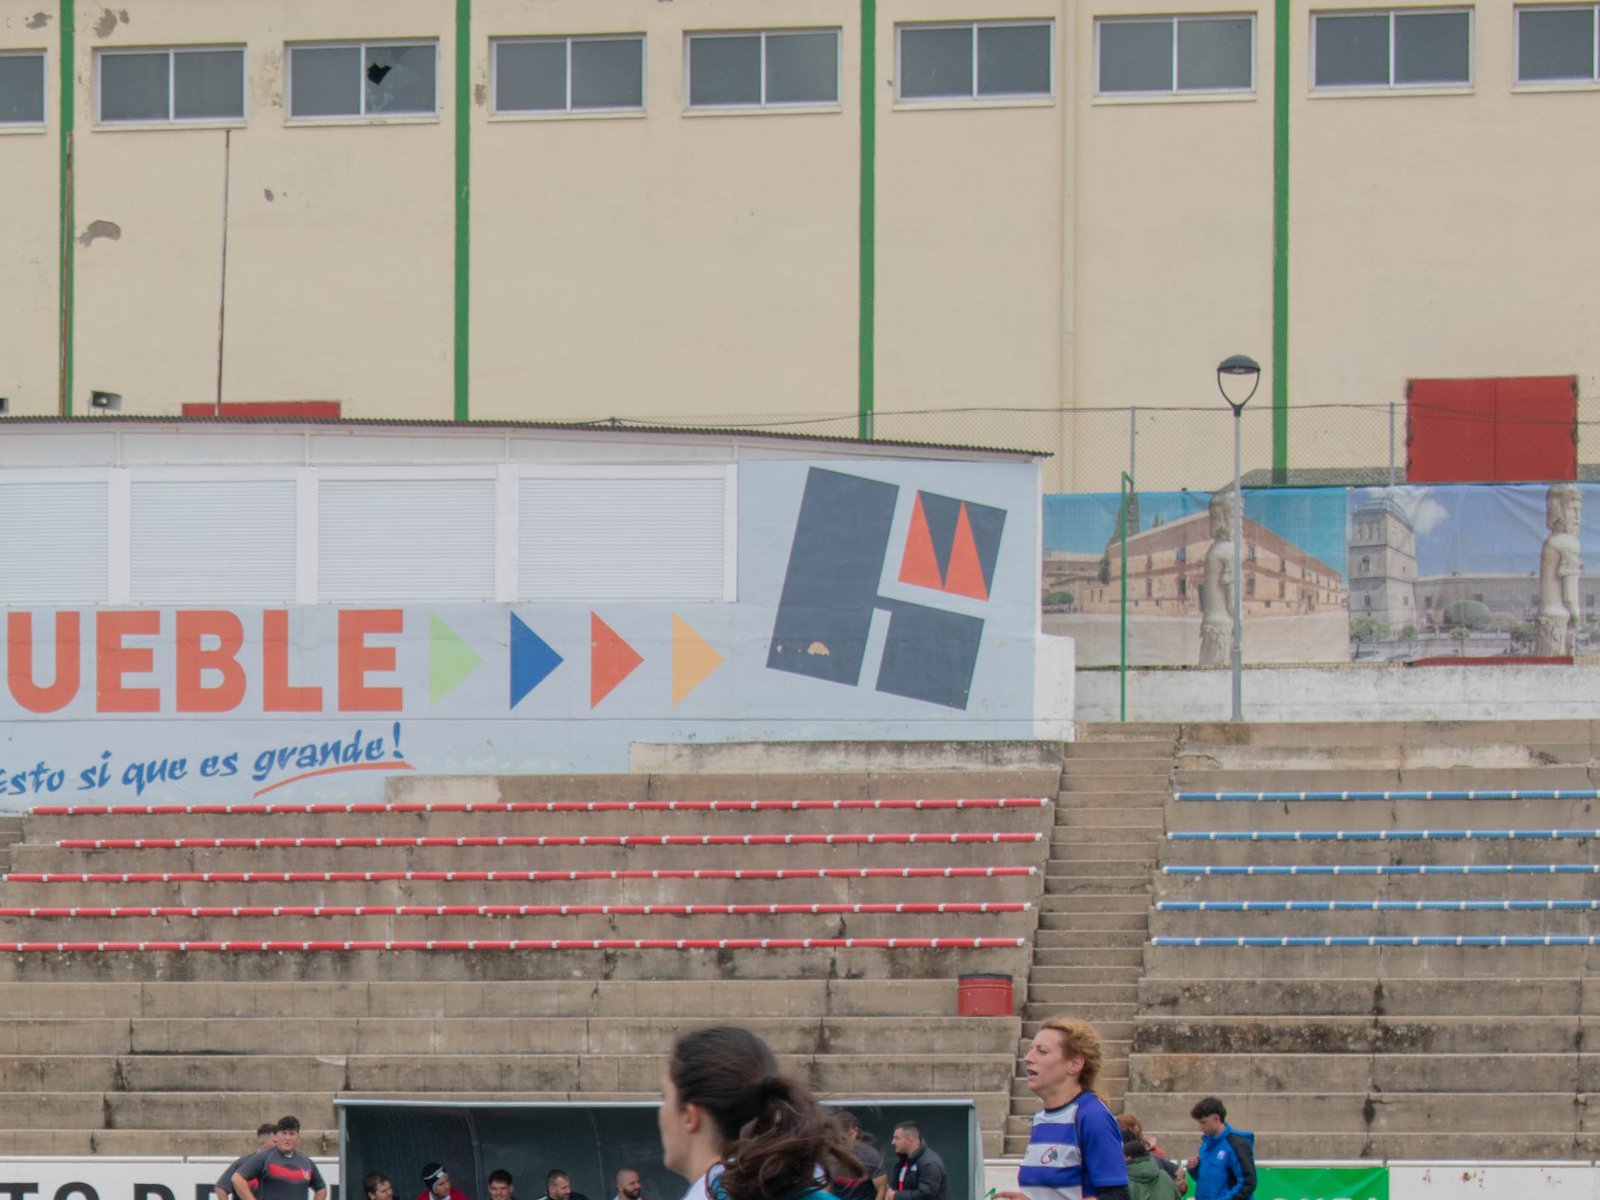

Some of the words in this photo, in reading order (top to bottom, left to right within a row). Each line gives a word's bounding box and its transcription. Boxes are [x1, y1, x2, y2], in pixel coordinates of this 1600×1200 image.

[7, 609, 404, 714] UEBLE
[77, 750, 112, 790] si
[122, 758, 188, 796] que
[200, 752, 238, 777] es
[252, 721, 404, 781] grande!
